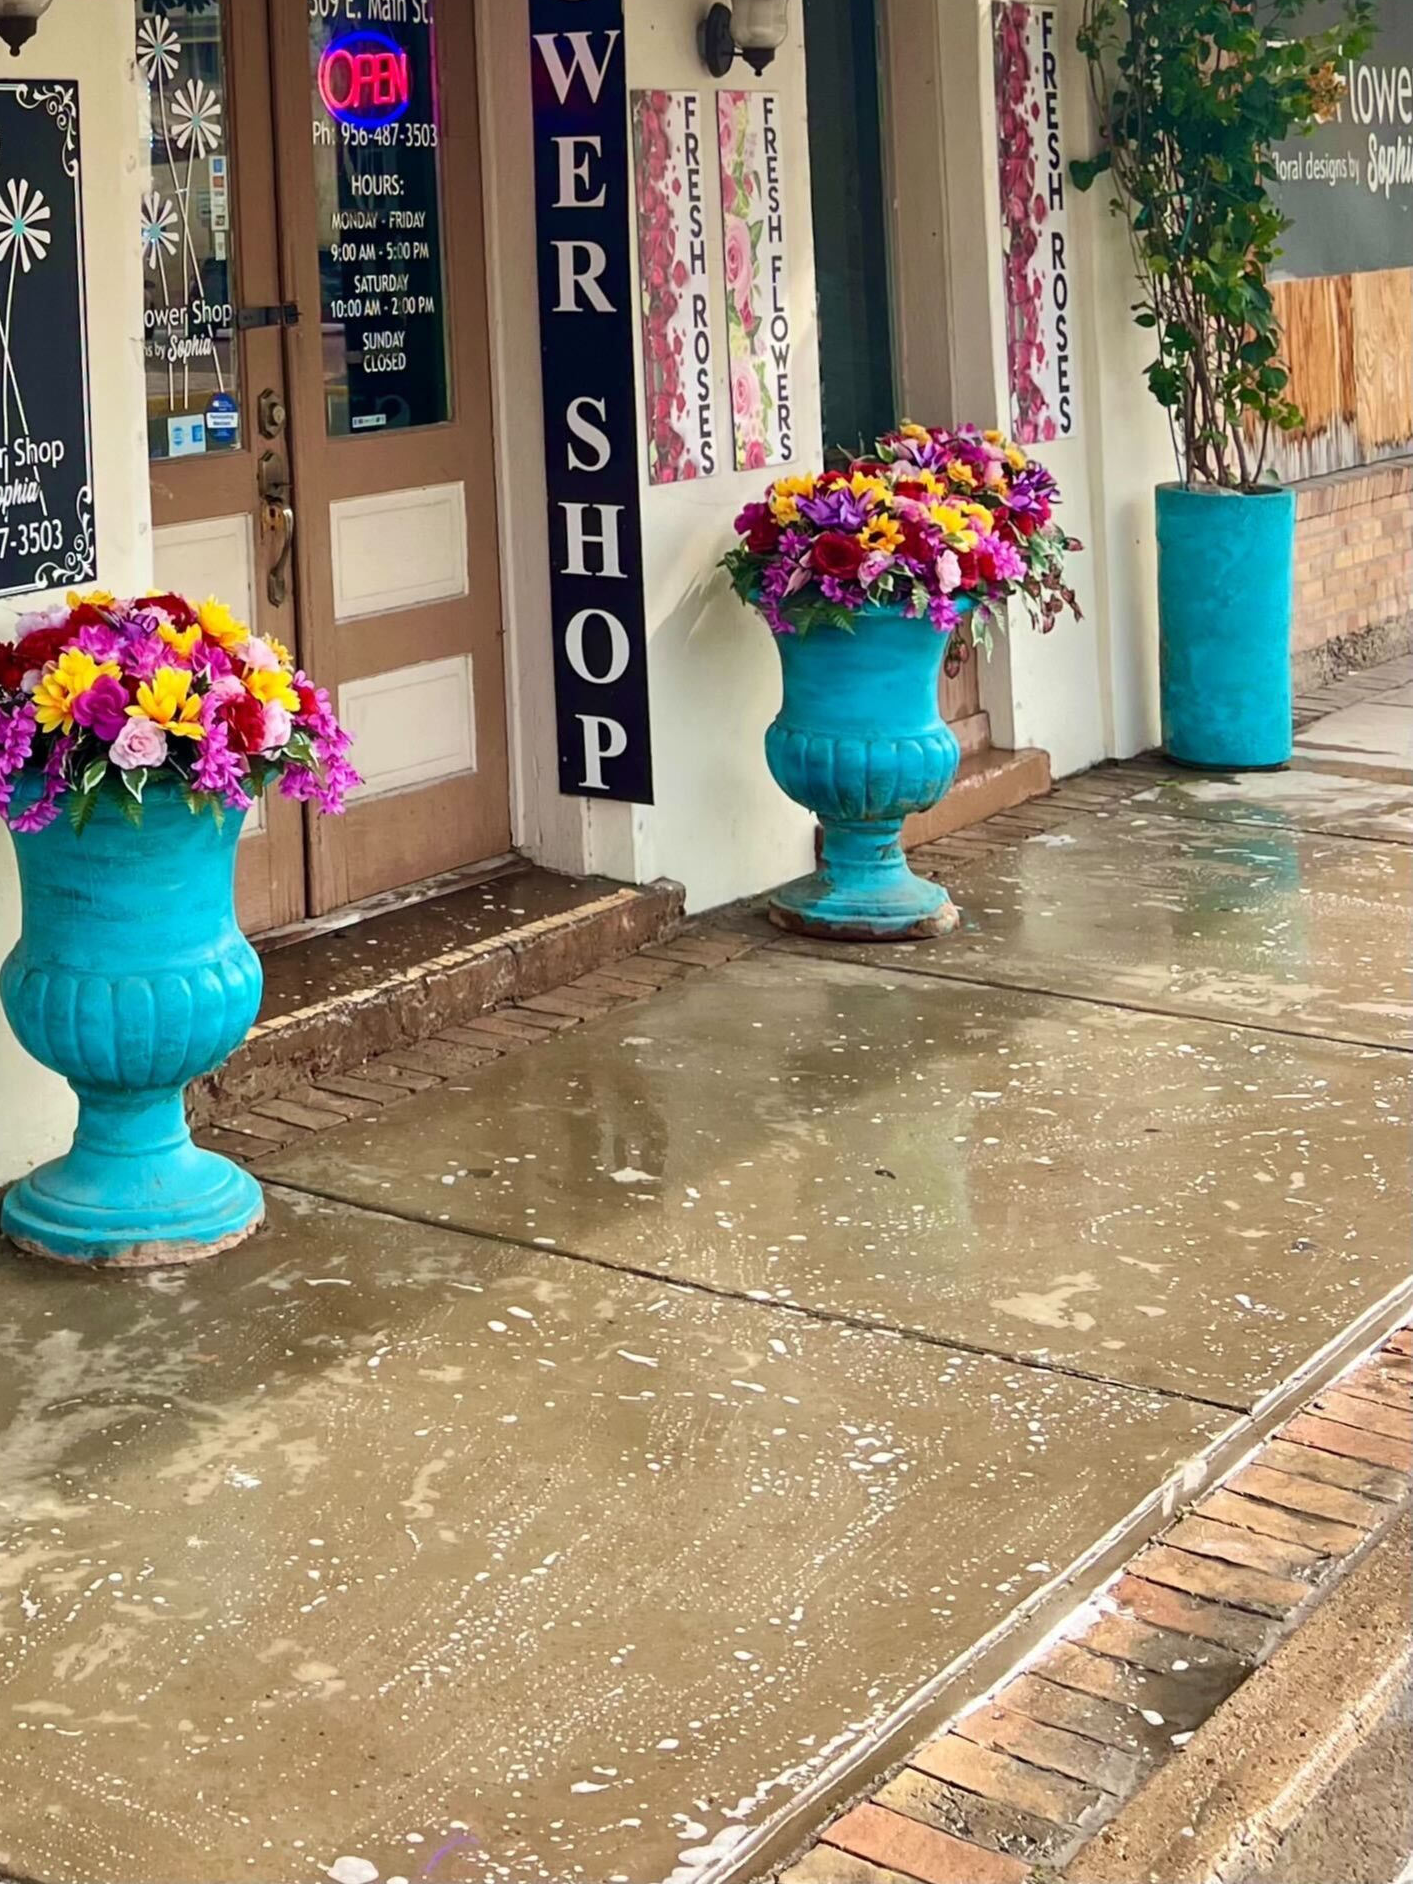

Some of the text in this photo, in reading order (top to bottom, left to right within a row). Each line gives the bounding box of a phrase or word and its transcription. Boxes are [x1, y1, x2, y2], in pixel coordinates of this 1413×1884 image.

[323, 49, 409, 109] OPEN
[1337, 45, 1413, 125] lowe
[312, 120, 438, 148] Ph: 956-487-3503
[1305, 150, 1348, 187] designs
[1347, 149, 1360, 186] by
[1367, 132, 1413, 200] Sophi
[351, 174, 405, 197] HOURS:
[331, 211, 379, 231] MONDAY
[388, 210, 426, 230] FRIDAY
[1041, 11, 1073, 435] FRESH ROSES
[330, 243, 357, 263] 9:00
[358, 243, 377, 261] AM
[386, 241, 411, 261] 5:00
[413, 241, 430, 260] PM
[354, 273, 410, 294] SATURDAY
[683, 95, 715, 476] FRESH ROSES
[761, 96, 793, 462] FRESH FLOWERS
[143, 299, 233, 329] ower Shop
[330, 298, 362, 319] 10:00
[363, 298, 382, 317] AM
[418, 296, 435, 314] PM
[167, 333, 213, 364] Sophia
[362, 330, 406, 351] SUNDAY
[363, 351, 407, 374] CLOSED
[13, 436, 65, 469] Shop
[557, 395, 631, 791] SHOP
